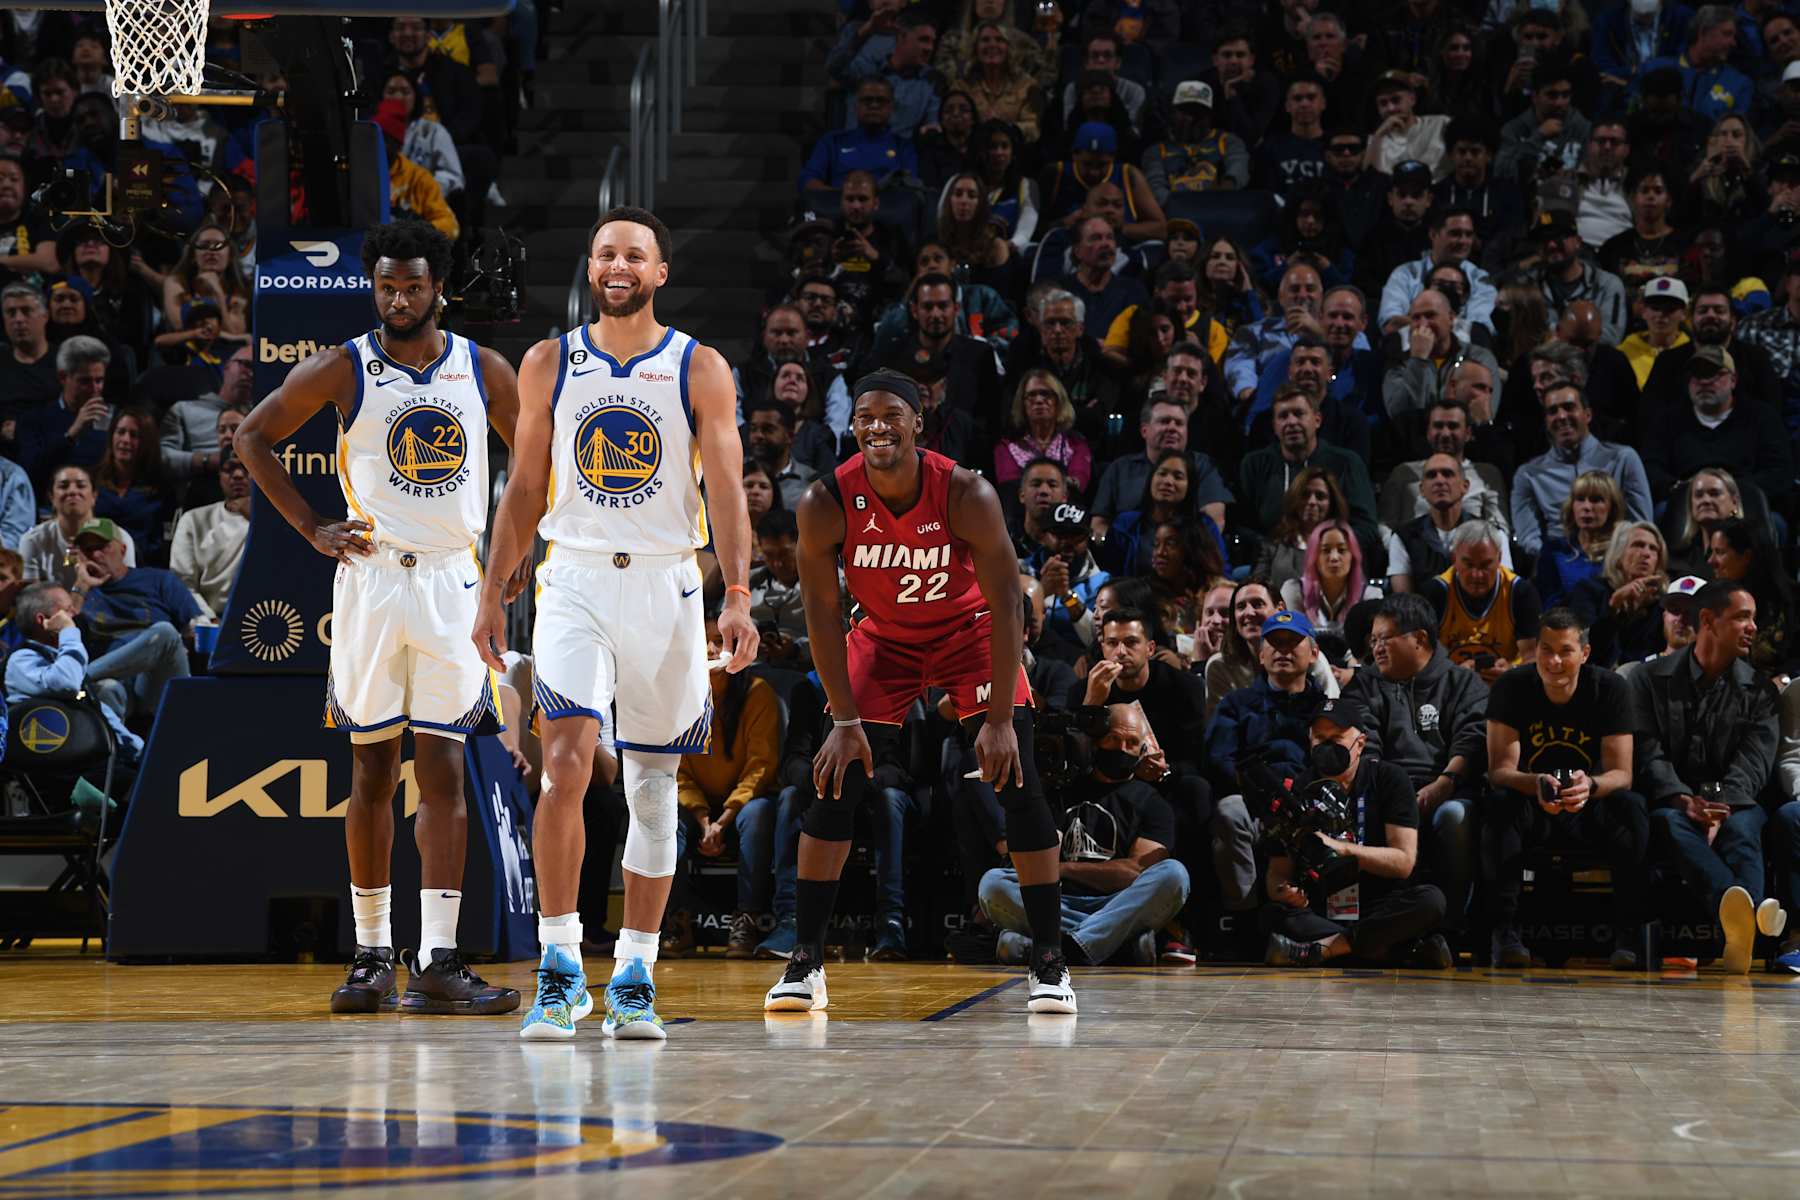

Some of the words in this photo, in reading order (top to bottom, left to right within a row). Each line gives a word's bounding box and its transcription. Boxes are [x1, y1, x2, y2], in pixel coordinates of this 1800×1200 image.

[260, 276, 372, 289] DOORDASH
[370, 361, 381, 374] 6
[573, 351, 585, 364] 6
[439, 373, 470, 382] Rakuten
[639, 371, 674, 383] Rakuten
[385, 396, 427, 425] GOLDEN
[432, 397, 465, 420] STATE
[575, 394, 624, 422] GOLDEN
[630, 396, 664, 426] STATE
[433, 425, 460, 447] 22
[624, 431, 654, 456] 30
[388, 466, 471, 499] WARRIORS
[576, 473, 664, 509] WARRIORS
[855, 495, 866, 509] 6
[1053, 503, 1086, 524] City
[852, 543, 951, 570] MIAMI
[896, 571, 950, 604] 22
[1531, 725, 1592, 748] CITY
